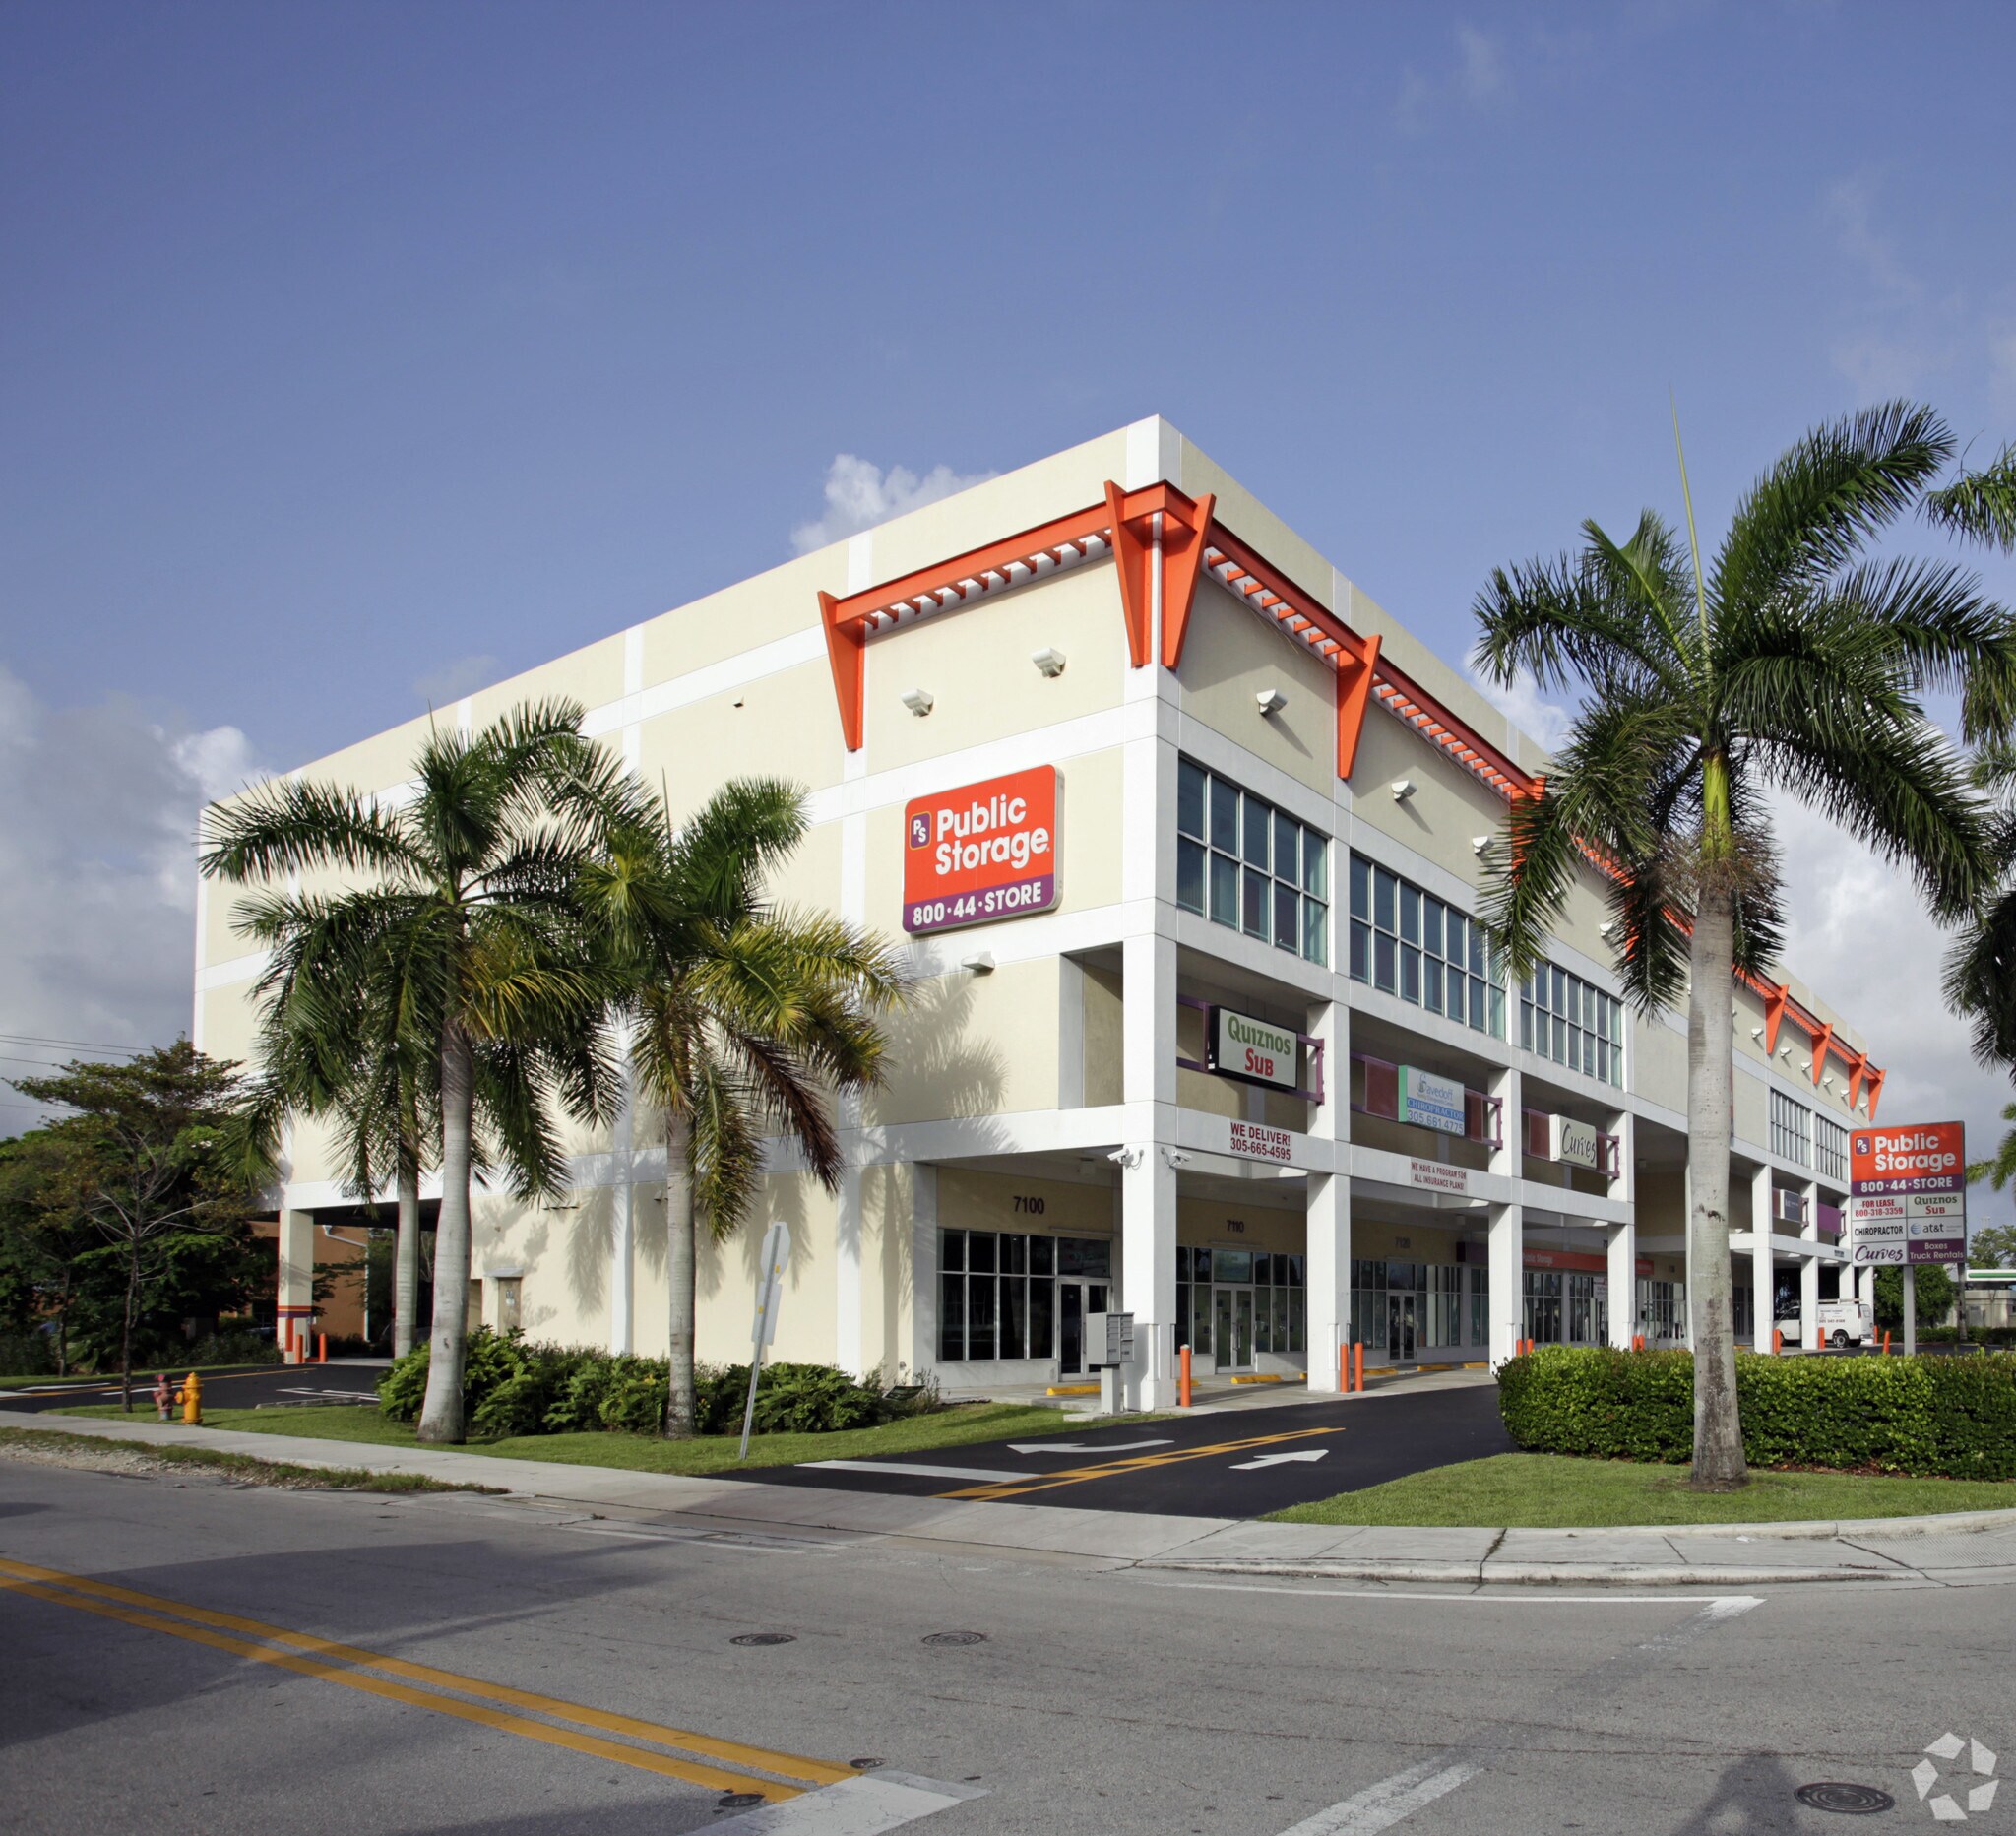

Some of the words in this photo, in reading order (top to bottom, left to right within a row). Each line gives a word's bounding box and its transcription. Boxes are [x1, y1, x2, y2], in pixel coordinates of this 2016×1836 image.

[937, 793, 1027, 842] Public
[913, 819, 927, 843] PS
[935, 827, 1049, 875] Storage
[1228, 1015, 1291, 1055] Quiznos
[1408, 1098, 1464, 1122] CHIROPRACTOR
[1230, 1122, 1245, 1137] WE
[1248, 1126, 1291, 1147] DELIVER!
[1561, 1123, 1596, 1164] Curves
[1874, 1133, 1939, 1153] Public
[1230, 1137, 1291, 1161] 305-665-4595
[1857, 1139, 1868, 1153] PS
[1874, 1153, 1957, 1172] Storage
[1013, 1196, 1045, 1215] 7100
[1914, 1196, 1958, 1206] Quiznos
[1855, 1207, 1904, 1218] 800-318-3359
[1855, 1226, 1904, 1236] CHIROPRACTOR
[1922, 1223, 1944, 1233] at&t
[1855, 1245, 1904, 1261] Curves
